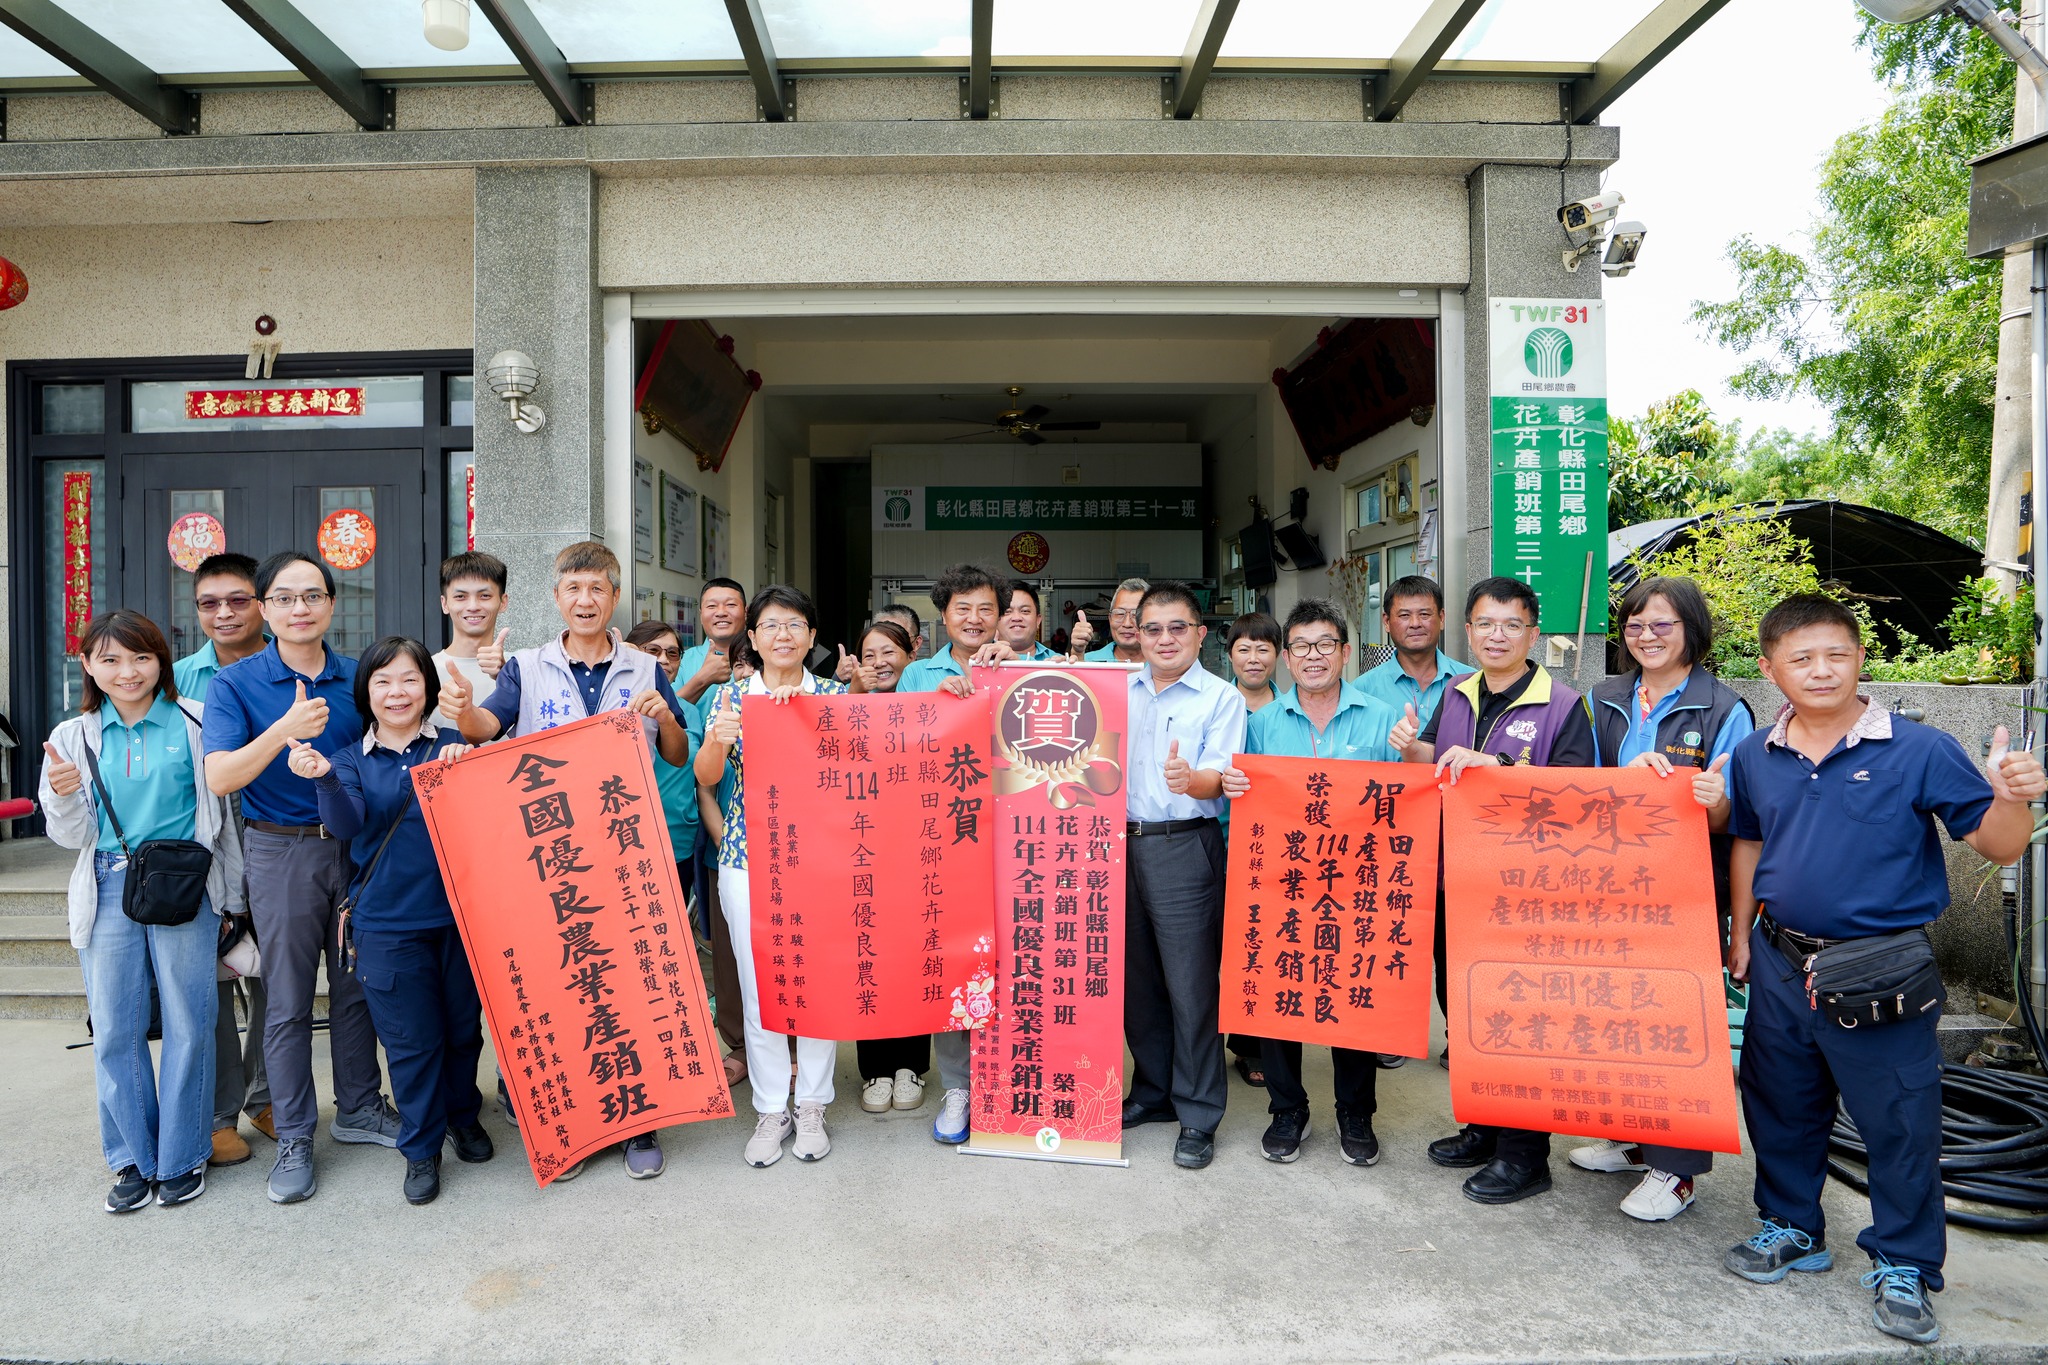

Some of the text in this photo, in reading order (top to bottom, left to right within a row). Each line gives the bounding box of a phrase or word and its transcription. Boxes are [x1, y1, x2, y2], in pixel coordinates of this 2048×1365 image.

[1509, 305, 1588, 323] TWF31
[1521, 382, 1577, 392] 田尾鄉農會
[1558, 404, 1587, 536] 彰化縣田尾鄉
[181, 516, 214, 549] 福
[333, 513, 365, 546] 春
[936, 499, 1196, 518] 彰化縣田尾鄉花卉產銷班第三十一班
[1513, 404, 1542, 624] 花卉產銷班第三十
[815, 705, 843, 792] 產銷班
[885, 703, 909, 786] 第31班
[1013, 688, 1087, 752] 賀
[599, 775, 645, 856] 恭賀
[941, 743, 989, 846] 恭賀
[1304, 772, 1332, 829] 榮獲
[1359, 778, 1405, 829] 賀
[1514, 798, 1628, 856] 恭賀
[845, 704, 880, 1017] 榮獲114年全國優良農業
[915, 703, 945, 1005] 彰化縣田尾鄉花卉產銷班
[1248, 822, 1265, 891] 彰化縣長
[1500, 865, 1657, 896] 田尾鄉花卉
[507, 753, 658, 1124] 全國優良農業產銷班
[786, 823, 807, 1009] 農業部 陳駿季部長
[1085, 869, 1109, 998] 彰化縣田尾鄉
[1274, 830, 1311, 1018] 農業產銷班
[1309, 833, 1349, 1024] 114年全國優良
[1348, 832, 1379, 1009] 產銷班第31班
[1384, 835, 1414, 980] 田尾鄉花卉
[1488, 895, 1676, 928] 產銷班第31班
[615, 867, 684, 1081] 第三十一班榮獲一一四年度
[637, 858, 704, 1079] 彰化縣田尾鄉花卉產銷班
[1010, 816, 1047, 1117] 114年全國優良農業產銷班
[1051, 815, 1078, 1119] 花卉產銷班第31班 榮獲
[1523, 934, 1634, 962] 榮獲114年
[503, 948, 531, 1014] 田尾鄉農會
[1241, 979, 1259, 1017] 敬賀
[1497, 970, 1664, 1011] 全國優良
[510, 1025, 533, 1080] 總幹事
[539, 1012, 563, 1069] 理事長
[786, 1017, 796, 1031] 賀
[1481, 1013, 1693, 1056] 農業產銷班
[1471, 1081, 1543, 1100] 彰化縣農會
[1551, 1088, 1613, 1106] 常務監事
[1620, 1094, 1669, 1112] 黃正盛
[1550, 1068, 1611, 1086] 理事長
[1553, 1108, 1614, 1126] 總幹事
